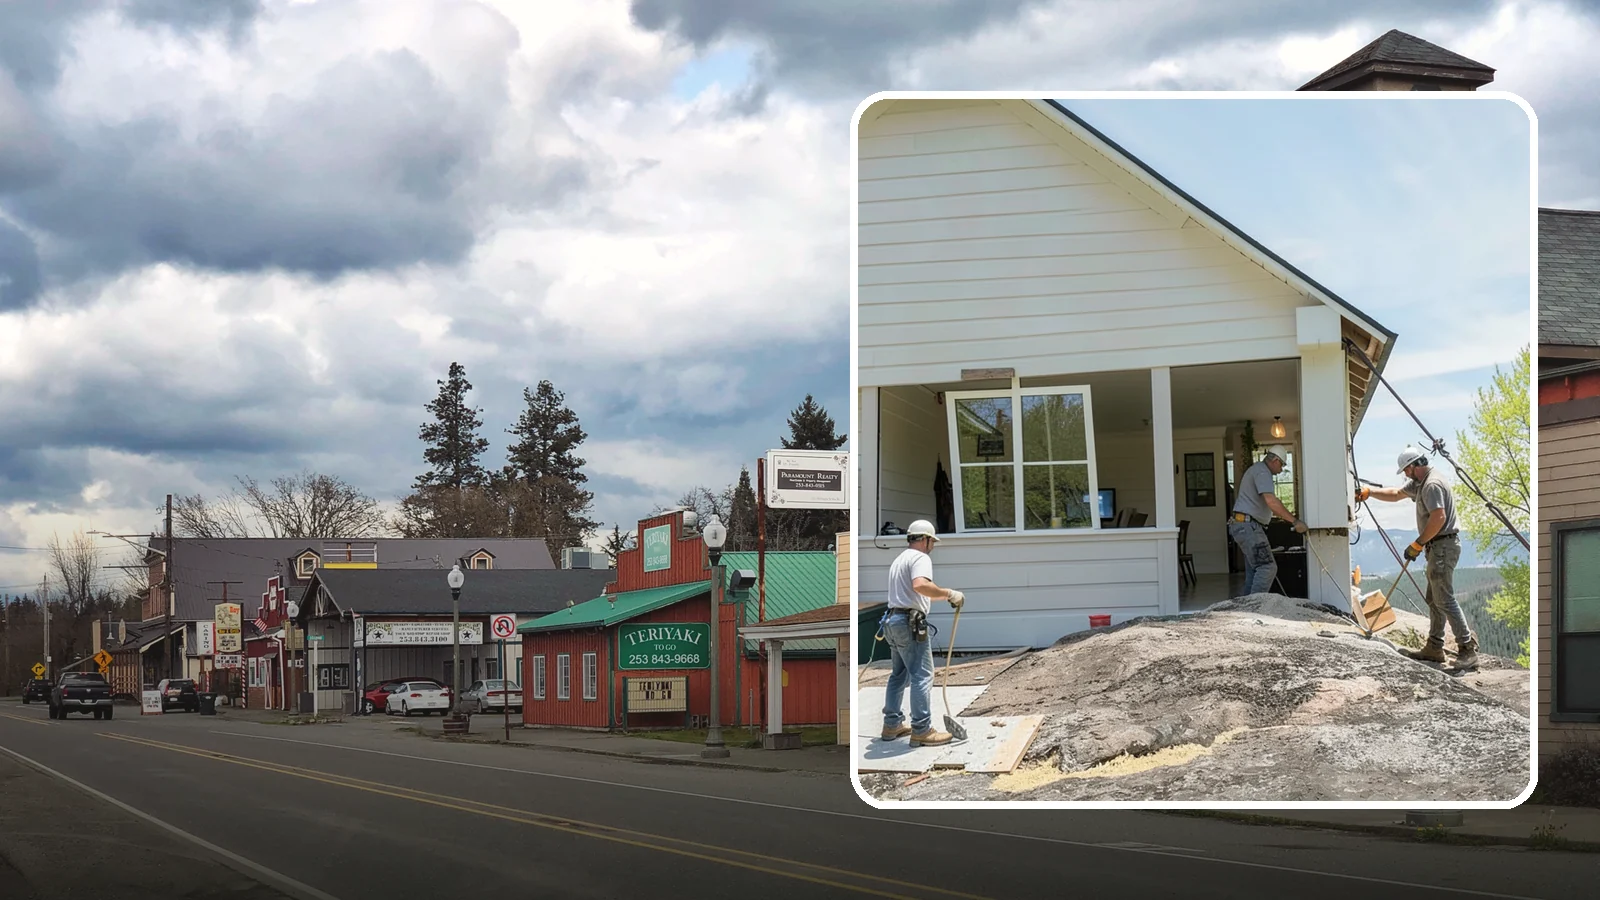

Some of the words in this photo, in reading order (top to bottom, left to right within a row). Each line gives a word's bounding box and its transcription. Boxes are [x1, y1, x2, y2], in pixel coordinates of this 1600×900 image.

[624, 627, 702, 646] TERIYAKI
[628, 654, 649, 665] 253
[651, 653, 700, 664] 843-9668
